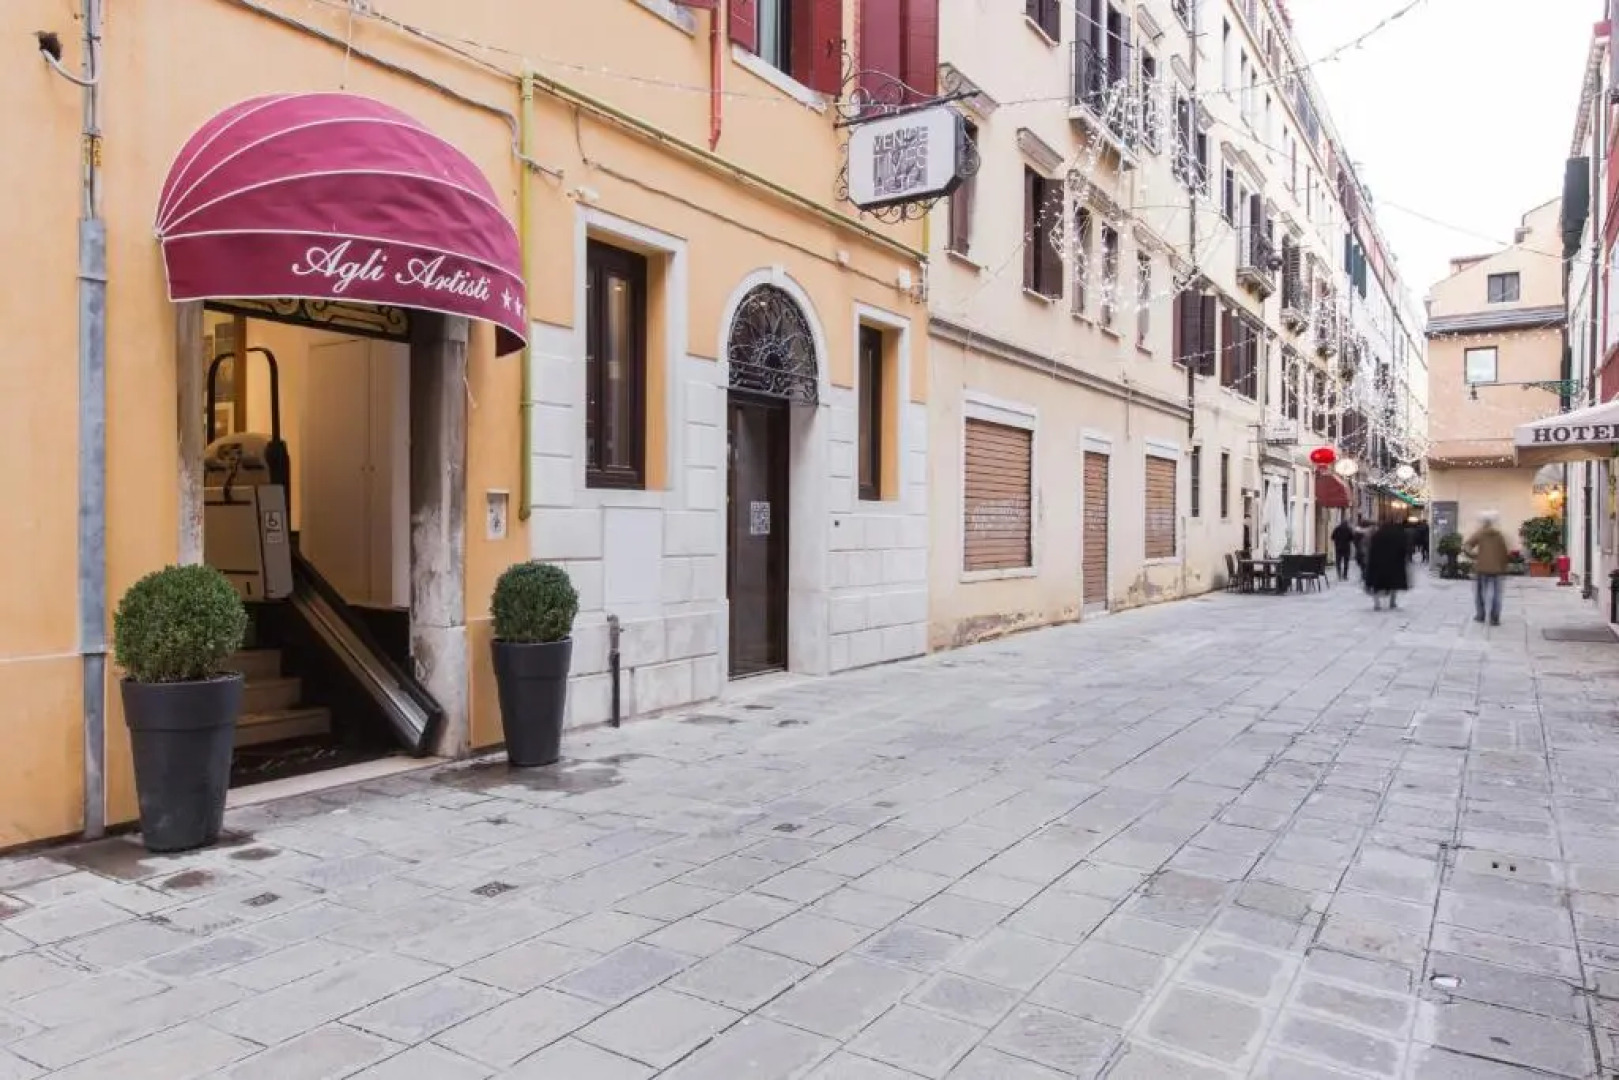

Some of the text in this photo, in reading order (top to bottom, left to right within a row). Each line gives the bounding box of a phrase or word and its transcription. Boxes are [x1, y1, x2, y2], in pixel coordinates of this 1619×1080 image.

[874, 127, 928, 151] VENICE
[874, 146, 928, 177] TIMES
[291, 240, 491, 302] Agli Artisti
